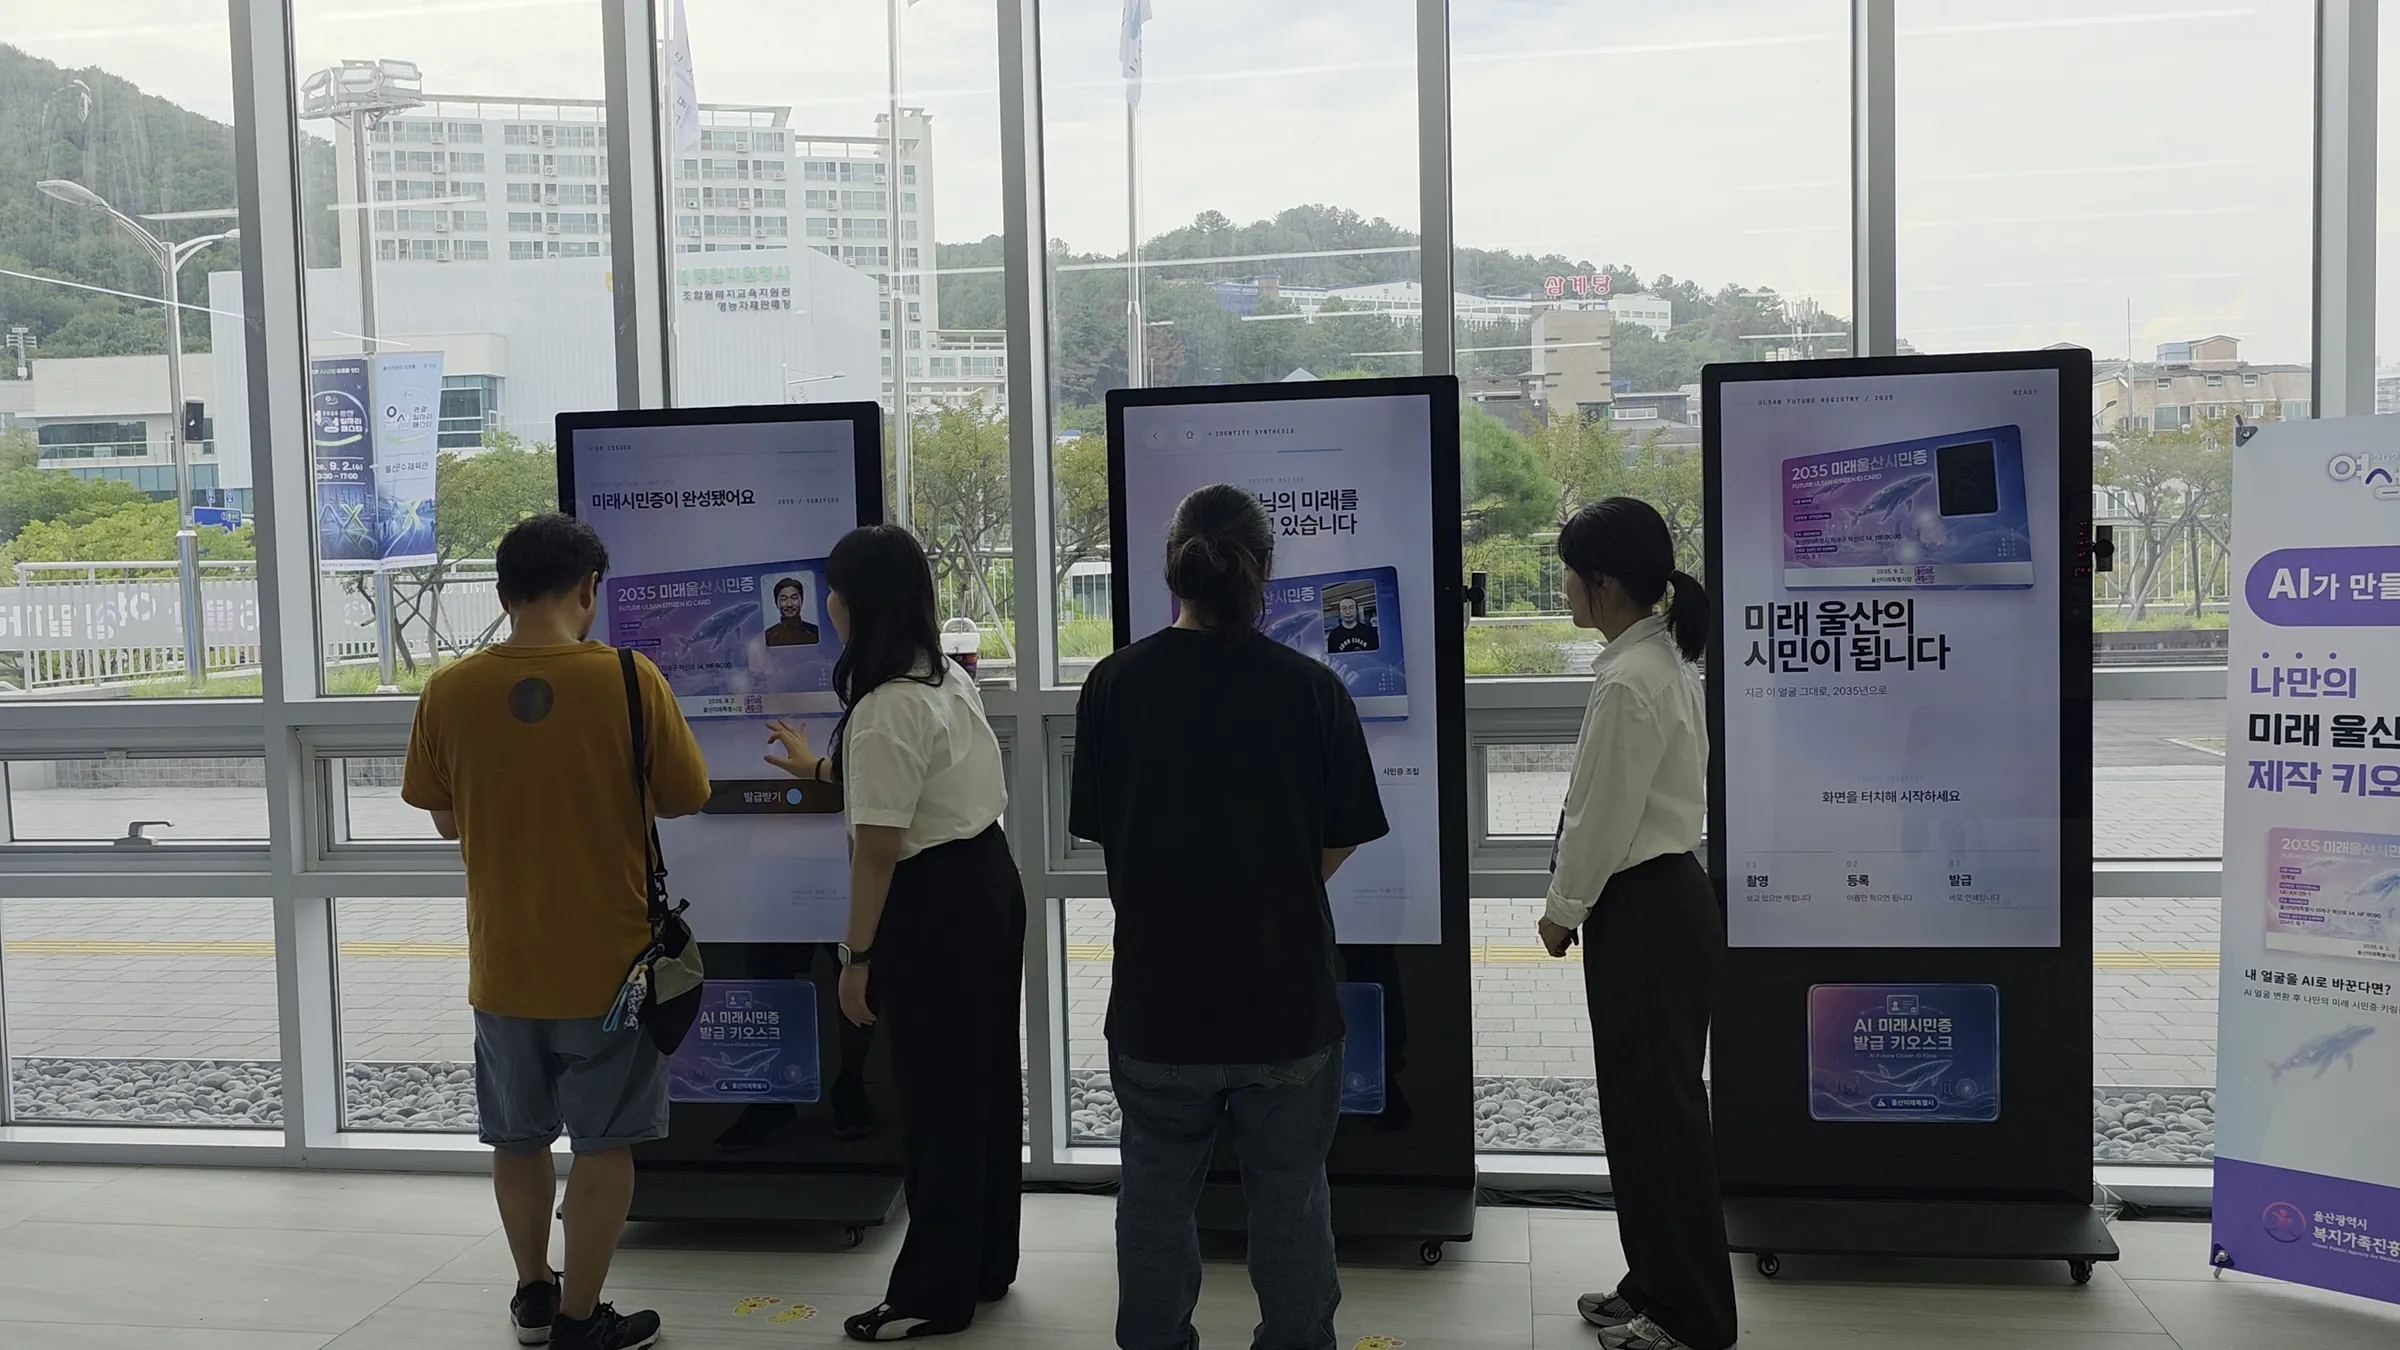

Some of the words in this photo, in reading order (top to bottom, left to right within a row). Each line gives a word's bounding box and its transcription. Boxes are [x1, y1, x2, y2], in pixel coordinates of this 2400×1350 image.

[1545, 274, 1612, 296] 삼계탕
[1787, 397, 1815, 405] FUTURE
[1820, 396, 1860, 404] REGISTRY
[1215, 429, 1250, 437] IDENTITY
[1255, 428, 1295, 436] SYNTHESIS
[1792, 464, 1828, 481] 2035
[1831, 449, 1928, 476] 미래울산시민증
[340, 472, 358, 480] 17:00
[592, 490, 678, 510] 미래시민증이
[681, 489, 756, 508] 완성됐어요
[1259, 490, 1296, 513] 님의
[1302, 489, 1359, 512] 미래를
[1280, 513, 1358, 536] 있습니다
[618, 586, 656, 602] 2035
[660, 576, 755, 599] 미래울산시민증
[2267, 568, 2340, 601] AI가
[1264, 586, 1315, 606] 산시민증
[1744, 600, 1809, 637] 미래
[1816, 598, 1914, 637] 울산의
[1744, 636, 1841, 674] 시민이
[1850, 634, 1951, 672] 됩니다
[1745, 687, 1764, 698] 지금
[1767, 687, 1776, 697] 이
[1778, 687, 1797, 698] 얼굴
[1800, 686, 1831, 698] 그대로,
[1833, 685, 1888, 696] 2035년으로
[2250, 666, 2357, 699] 나만의
[2248, 712, 2320, 747] 미래
[1383, 768, 1404, 776] 시민증
[1406, 767, 1420, 776] 조립
[2247, 760, 2322, 795] 제작
[743, 791, 782, 803] 발급받기
[1822, 790, 1858, 804] 화면을
[1861, 790, 1897, 803] 터치해
[1900, 790, 1961, 803] 시작하세요
[2281, 838, 2320, 853] 2035
[1746, 874, 1769, 888] 촬영
[1846, 874, 1870, 887] 등록
[1949, 873, 1972, 887] 발급
[2245, 969, 2257, 981] 내
[2261, 970, 2298, 986] 얼굴을
[2301, 975, 2328, 988] AI로
[2332, 978, 2391, 996] 바꾼다면?
[2254, 989, 2270, 1000] 얼굴
[2273, 991, 2290, 1002] 변환
[2293, 993, 2301, 1003] 후
[2303, 995, 2329, 1006] 나만의
[2332, 998, 2349, 1008] 미래
[2351, 1001, 2378, 1012] 시민증
[2380, 1004, 2400, 1015] 키링
[700, 1011, 715, 1024] AI
[719, 1011, 780, 1025] 미래시민증
[1853, 1018, 1872, 1033] AI
[1878, 1018, 1953, 1033] 미래시민증
[700, 1026, 725, 1040] 발급
[729, 1026, 781, 1040] 키오스크
[1853, 1035, 1884, 1051] 발급
[1890, 1035, 1953, 1050] 키오스크
[2313, 1210, 2368, 1231] 울산광역시
